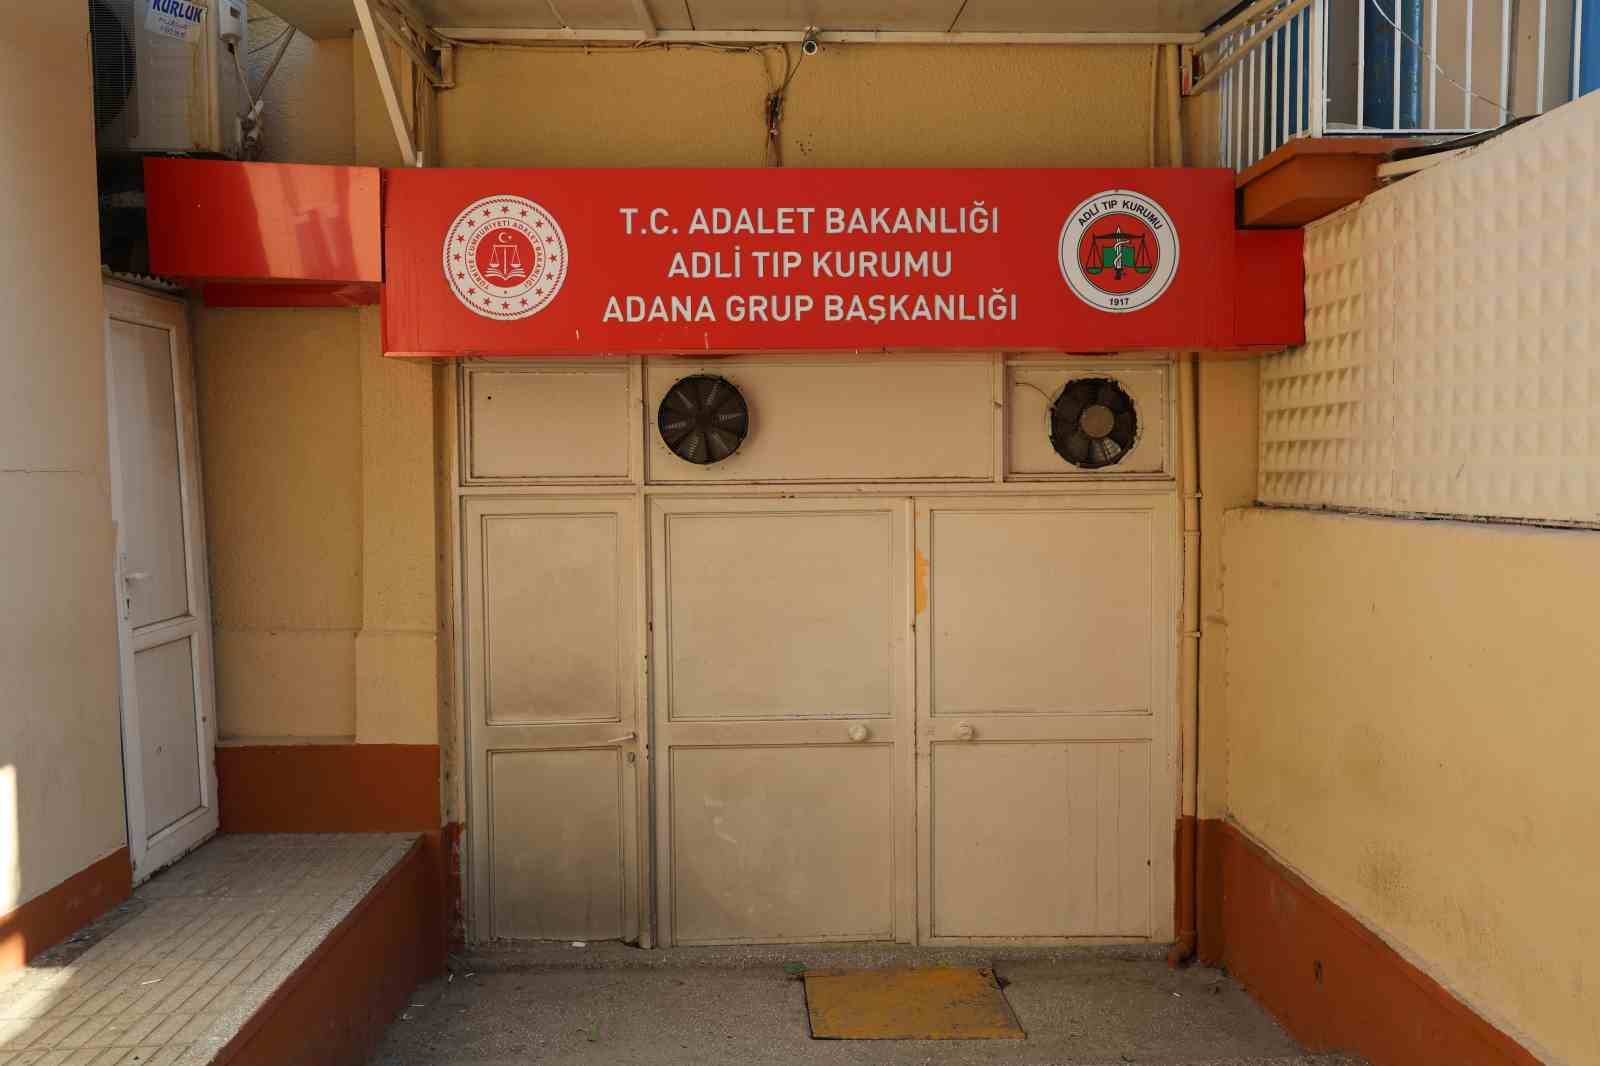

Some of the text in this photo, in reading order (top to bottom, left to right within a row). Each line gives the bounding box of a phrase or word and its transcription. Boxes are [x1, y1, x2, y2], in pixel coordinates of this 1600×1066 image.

[620, 200, 999, 235] T.C. ADALET BAKANLIĞI
[1078, 199, 1163, 230] ADLİ TIP KURUMU
[667, 245, 953, 279] ADLİ TIP KURUMU
[602, 287, 1018, 325] ADANA GRUP BAŞKANLIĞI
[1109, 297, 1129, 306] 1917
